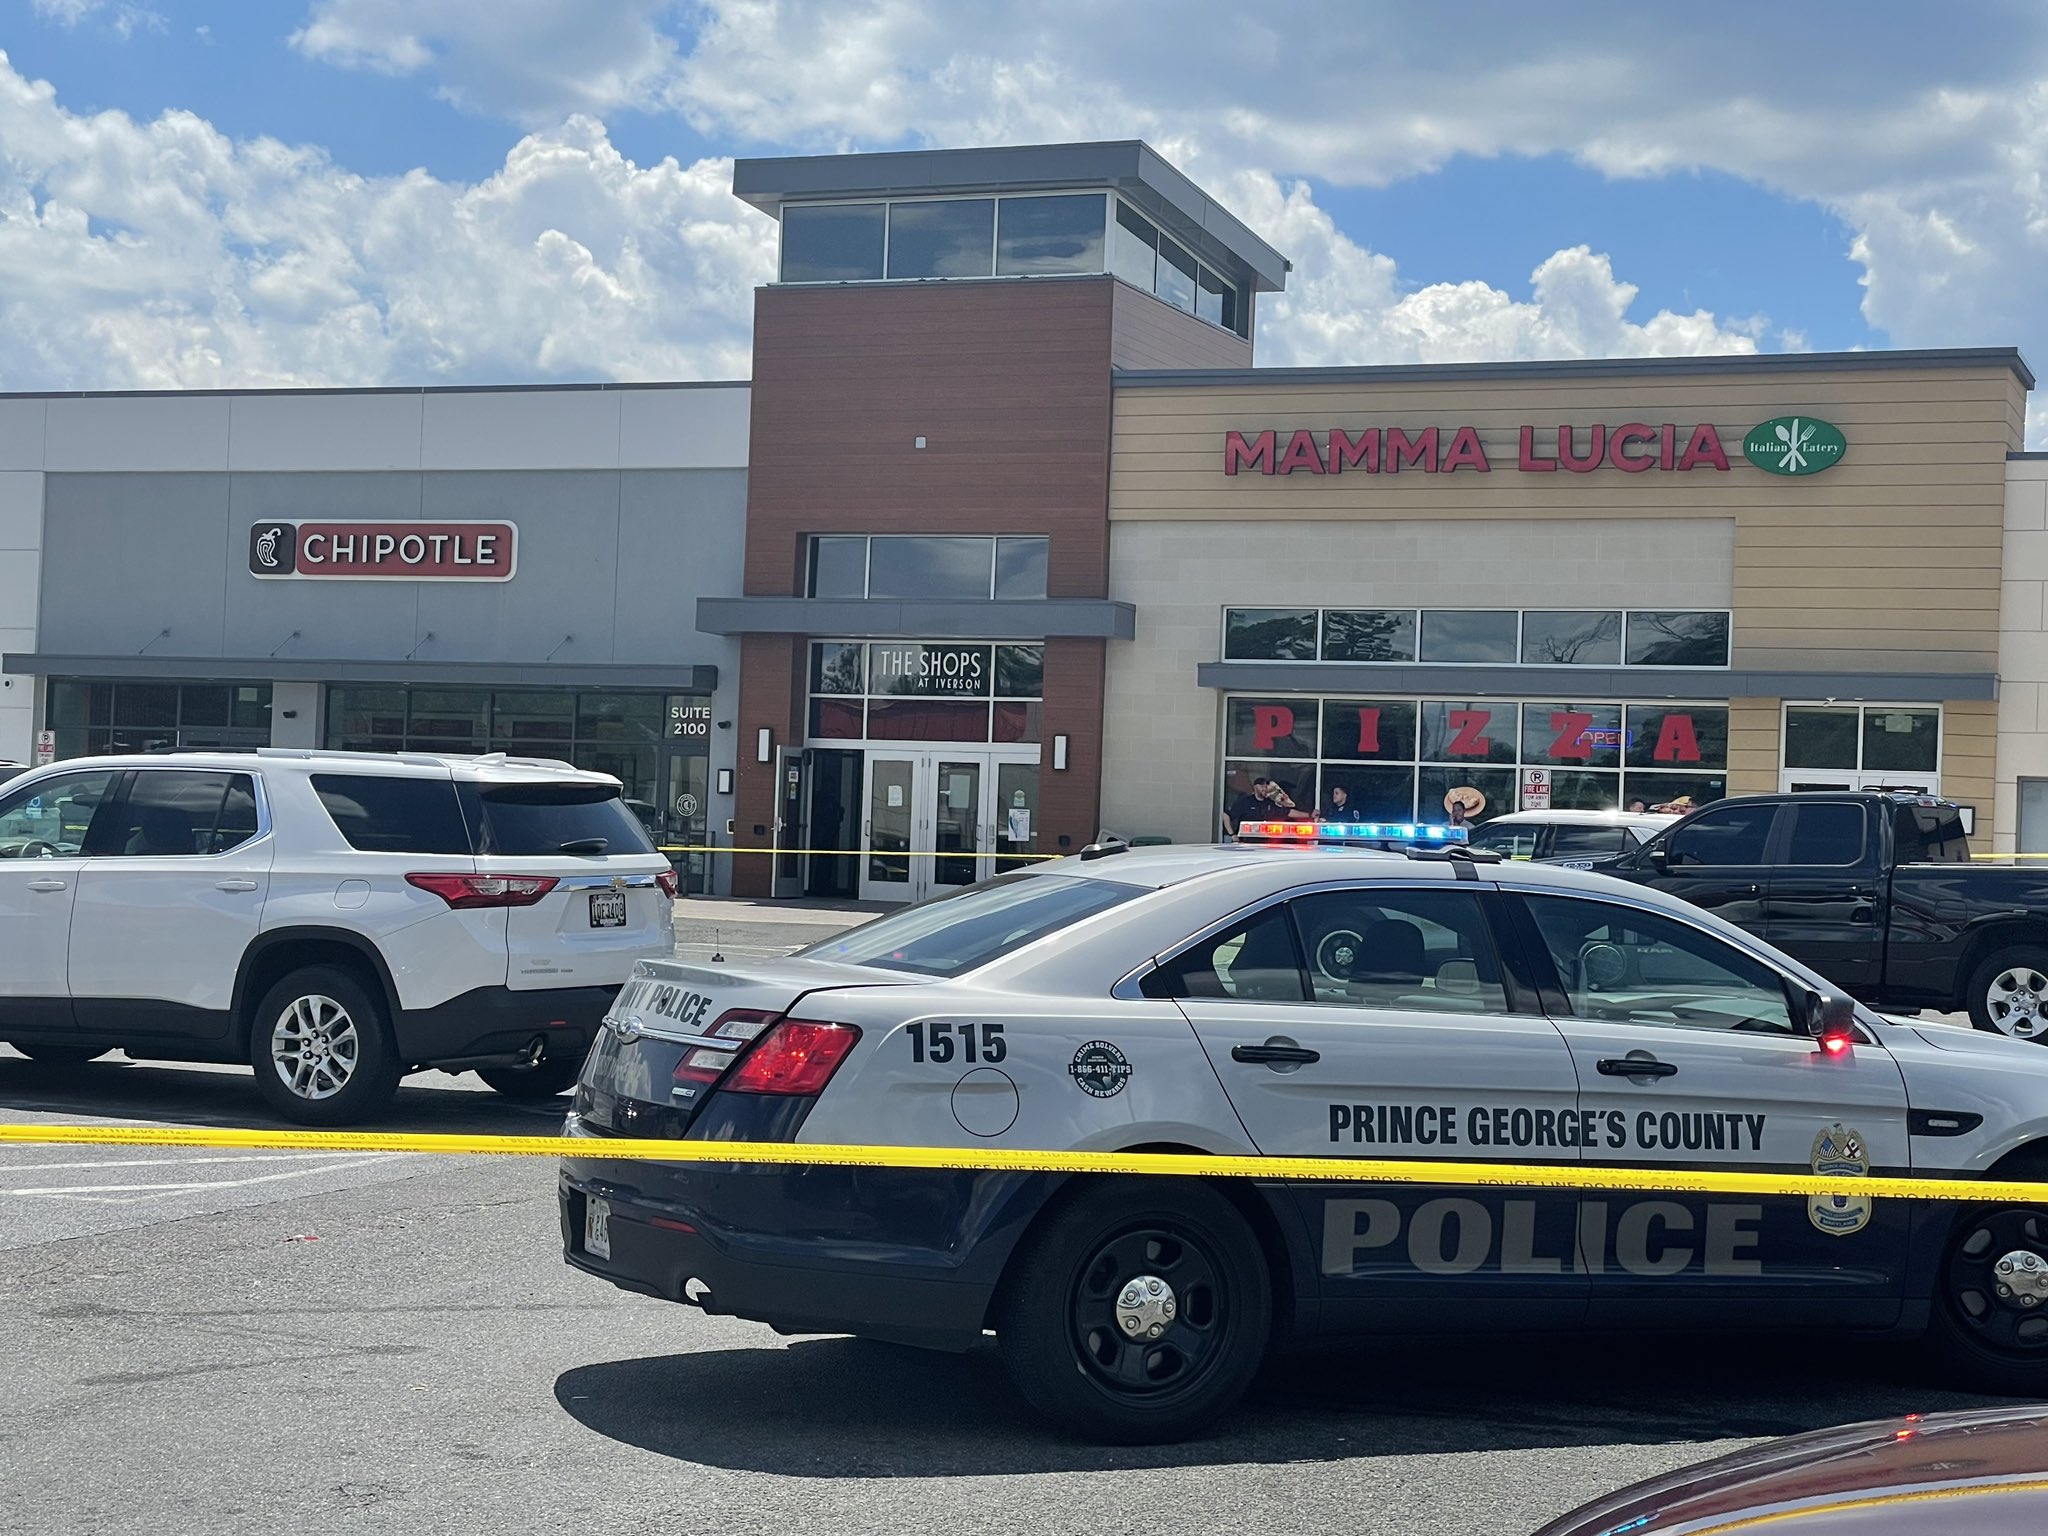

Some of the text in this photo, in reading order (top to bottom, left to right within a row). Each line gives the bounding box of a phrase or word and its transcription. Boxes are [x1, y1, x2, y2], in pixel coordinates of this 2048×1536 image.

[1224, 422, 1731, 476] MAMMA LUCIA
[1750, 442, 1839, 454] Italian Eatery
[303, 534, 497, 564] CHIPOTLE
[881, 651, 981, 677] THE SHOPS
[918, 678, 980, 689] AT IVERSON
[671, 707, 711, 719] SUITE
[674, 723, 706, 735] 2100
[1253, 705, 1700, 761] PIZZA
[646, 984, 712, 1027] POLICE
[906, 1022, 1007, 1063] 1515
[1075, 1042, 1124, 1063] CRIME SOLVERS
[1070, 1065, 1131, 1074] 1-866-411-TIPS
[1077, 1077, 1126, 1097] CASH REWARDS
[1329, 1105, 1767, 1150] PRINCE GEORGE'S COUNTY
[1322, 1197, 1764, 1276] POLICE
